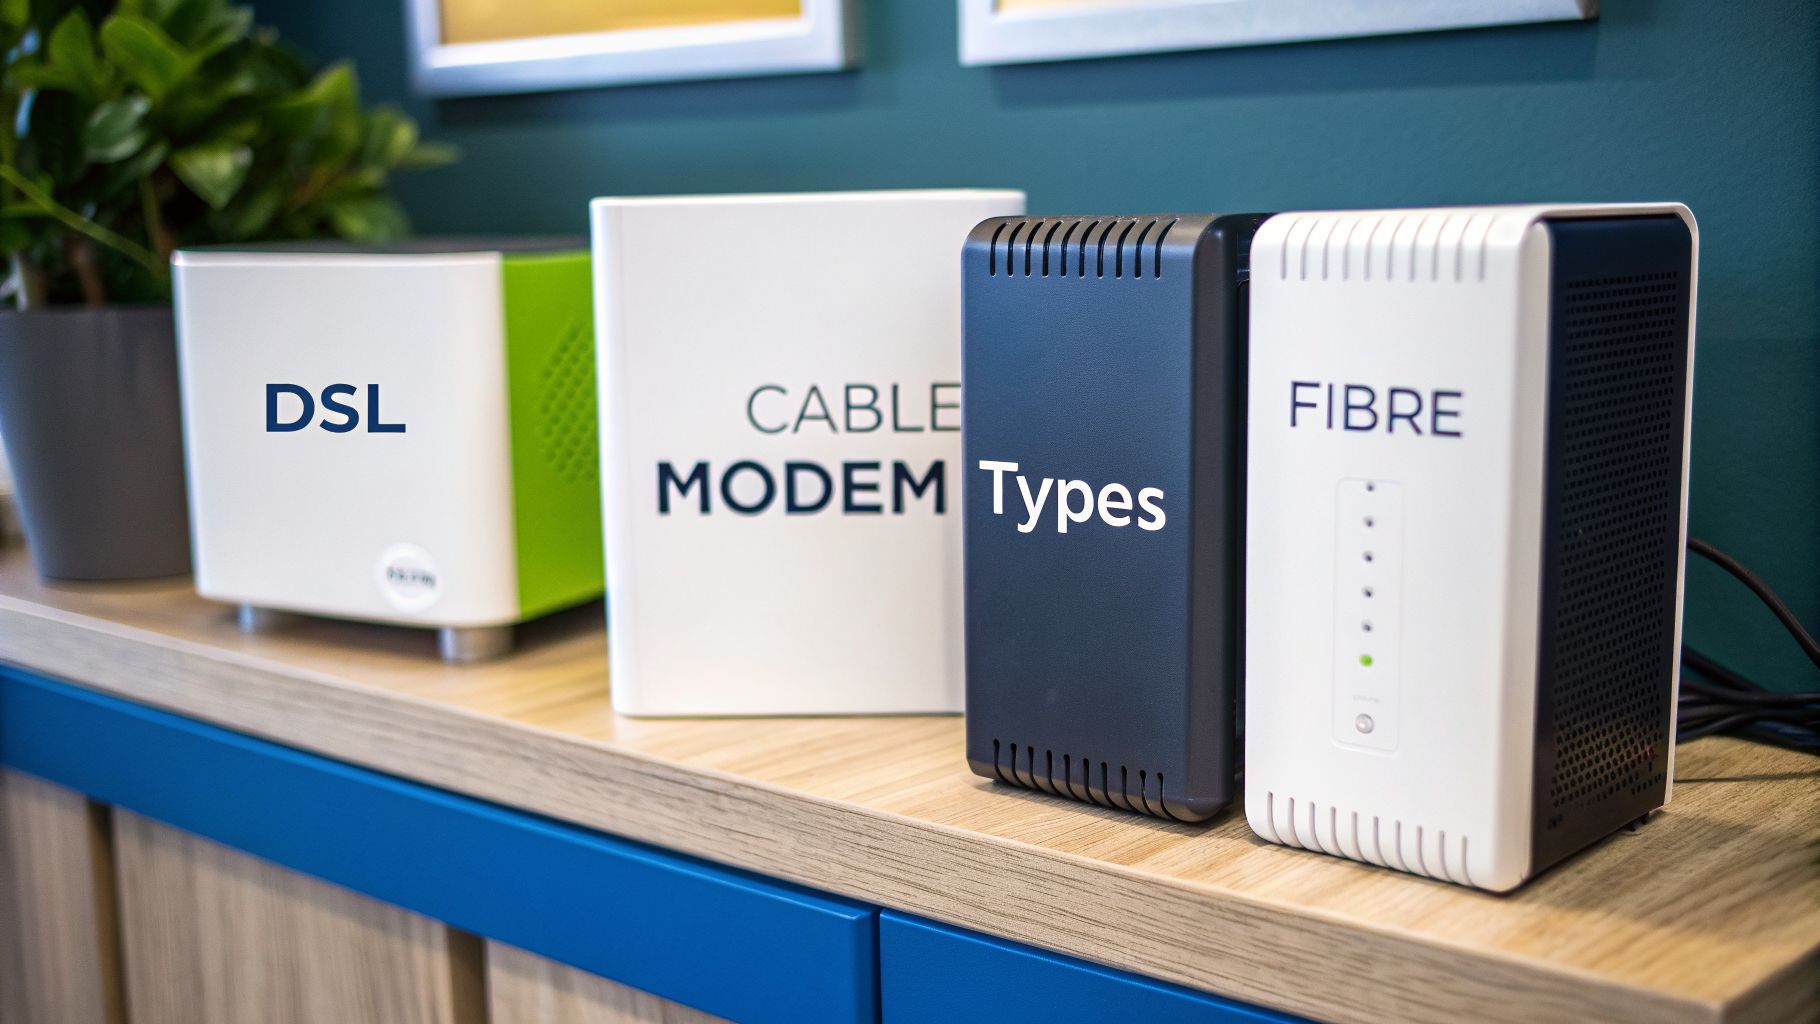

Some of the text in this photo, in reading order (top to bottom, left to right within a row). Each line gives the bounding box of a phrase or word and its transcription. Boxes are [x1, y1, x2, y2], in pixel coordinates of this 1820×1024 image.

[264, 383, 407, 434] DSL
[746, 382, 961, 434] CABLE
[1290, 381, 1463, 438] FIBRE
[657, 459, 947, 516] MODEM
[979, 460, 1167, 534] Types
